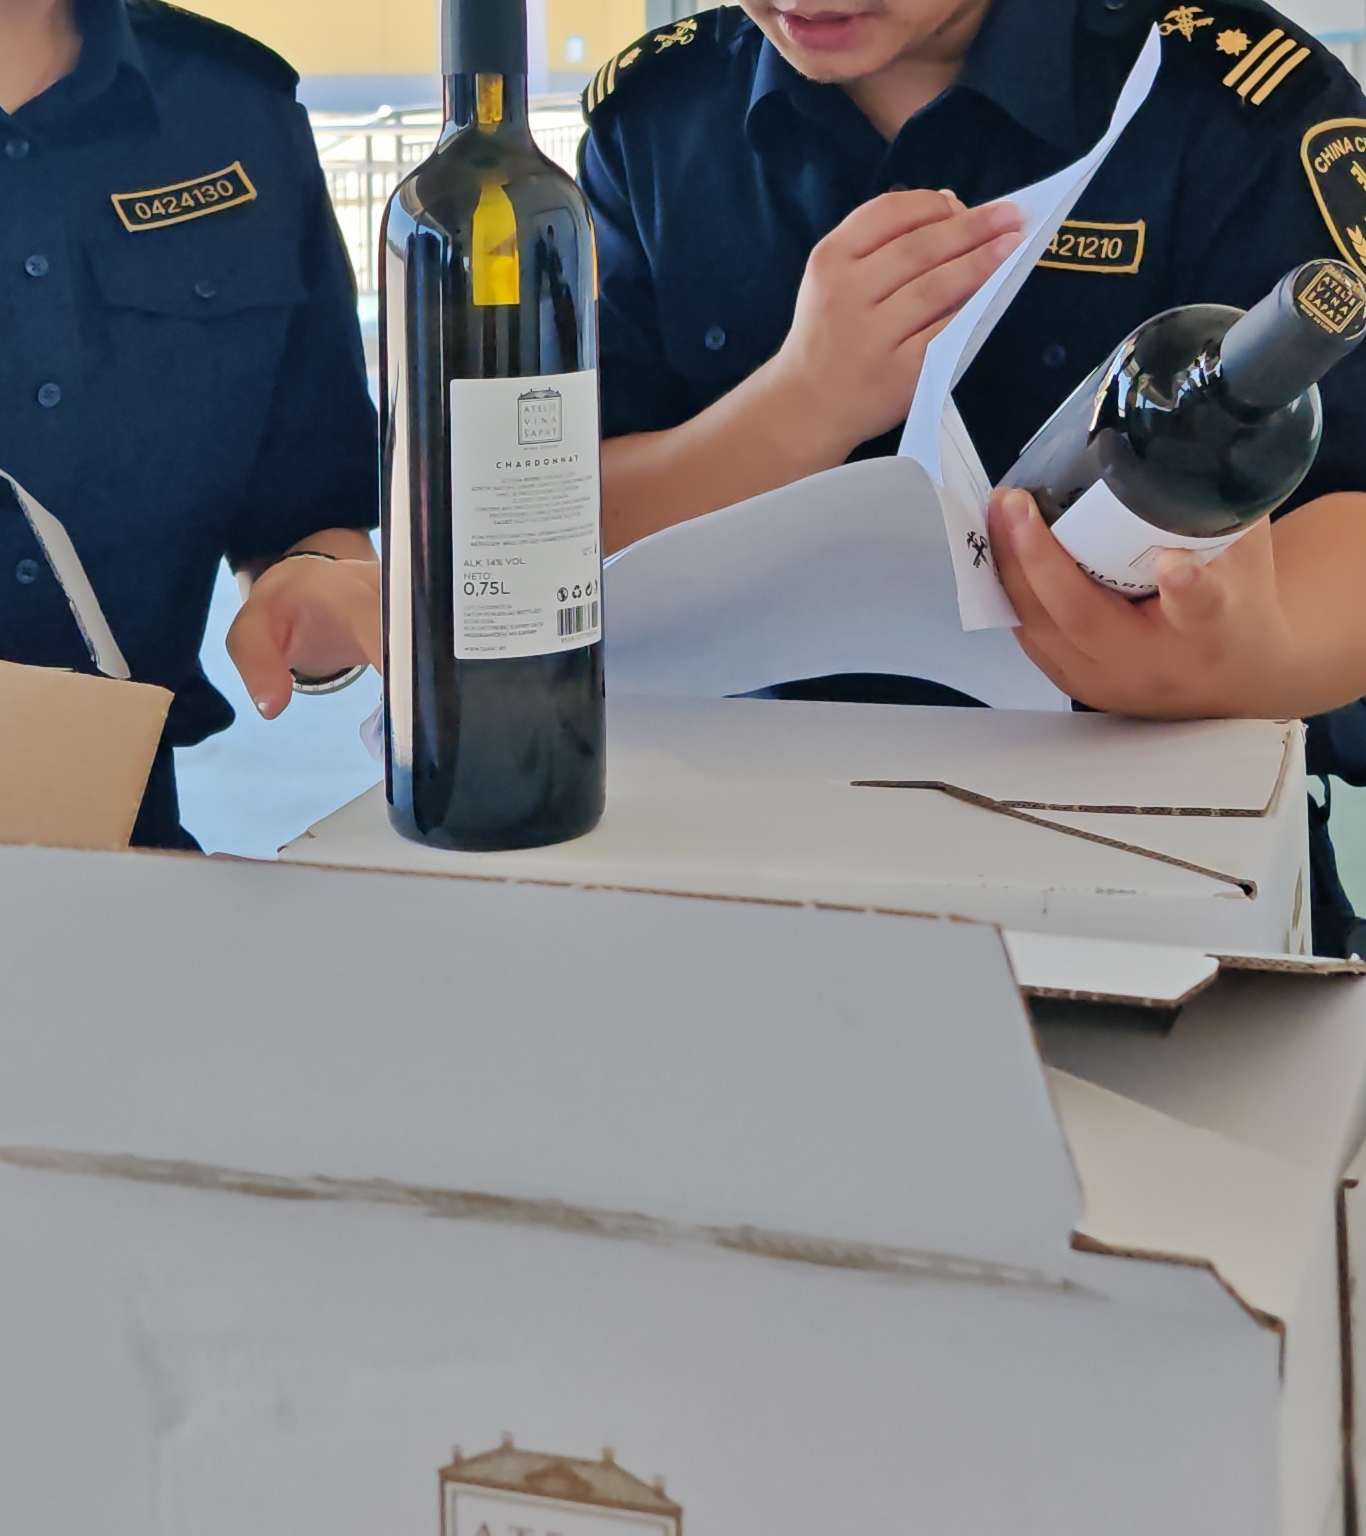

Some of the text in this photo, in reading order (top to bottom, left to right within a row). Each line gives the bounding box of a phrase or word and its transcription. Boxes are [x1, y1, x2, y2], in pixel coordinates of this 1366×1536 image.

[1314, 136, 1354, 174] CHINA
[134, 179, 234, 220] 0424130
[505, 557, 526, 566] VOL
[463, 572, 491, 581] NETO
[463, 581, 511, 597] 0,75L
